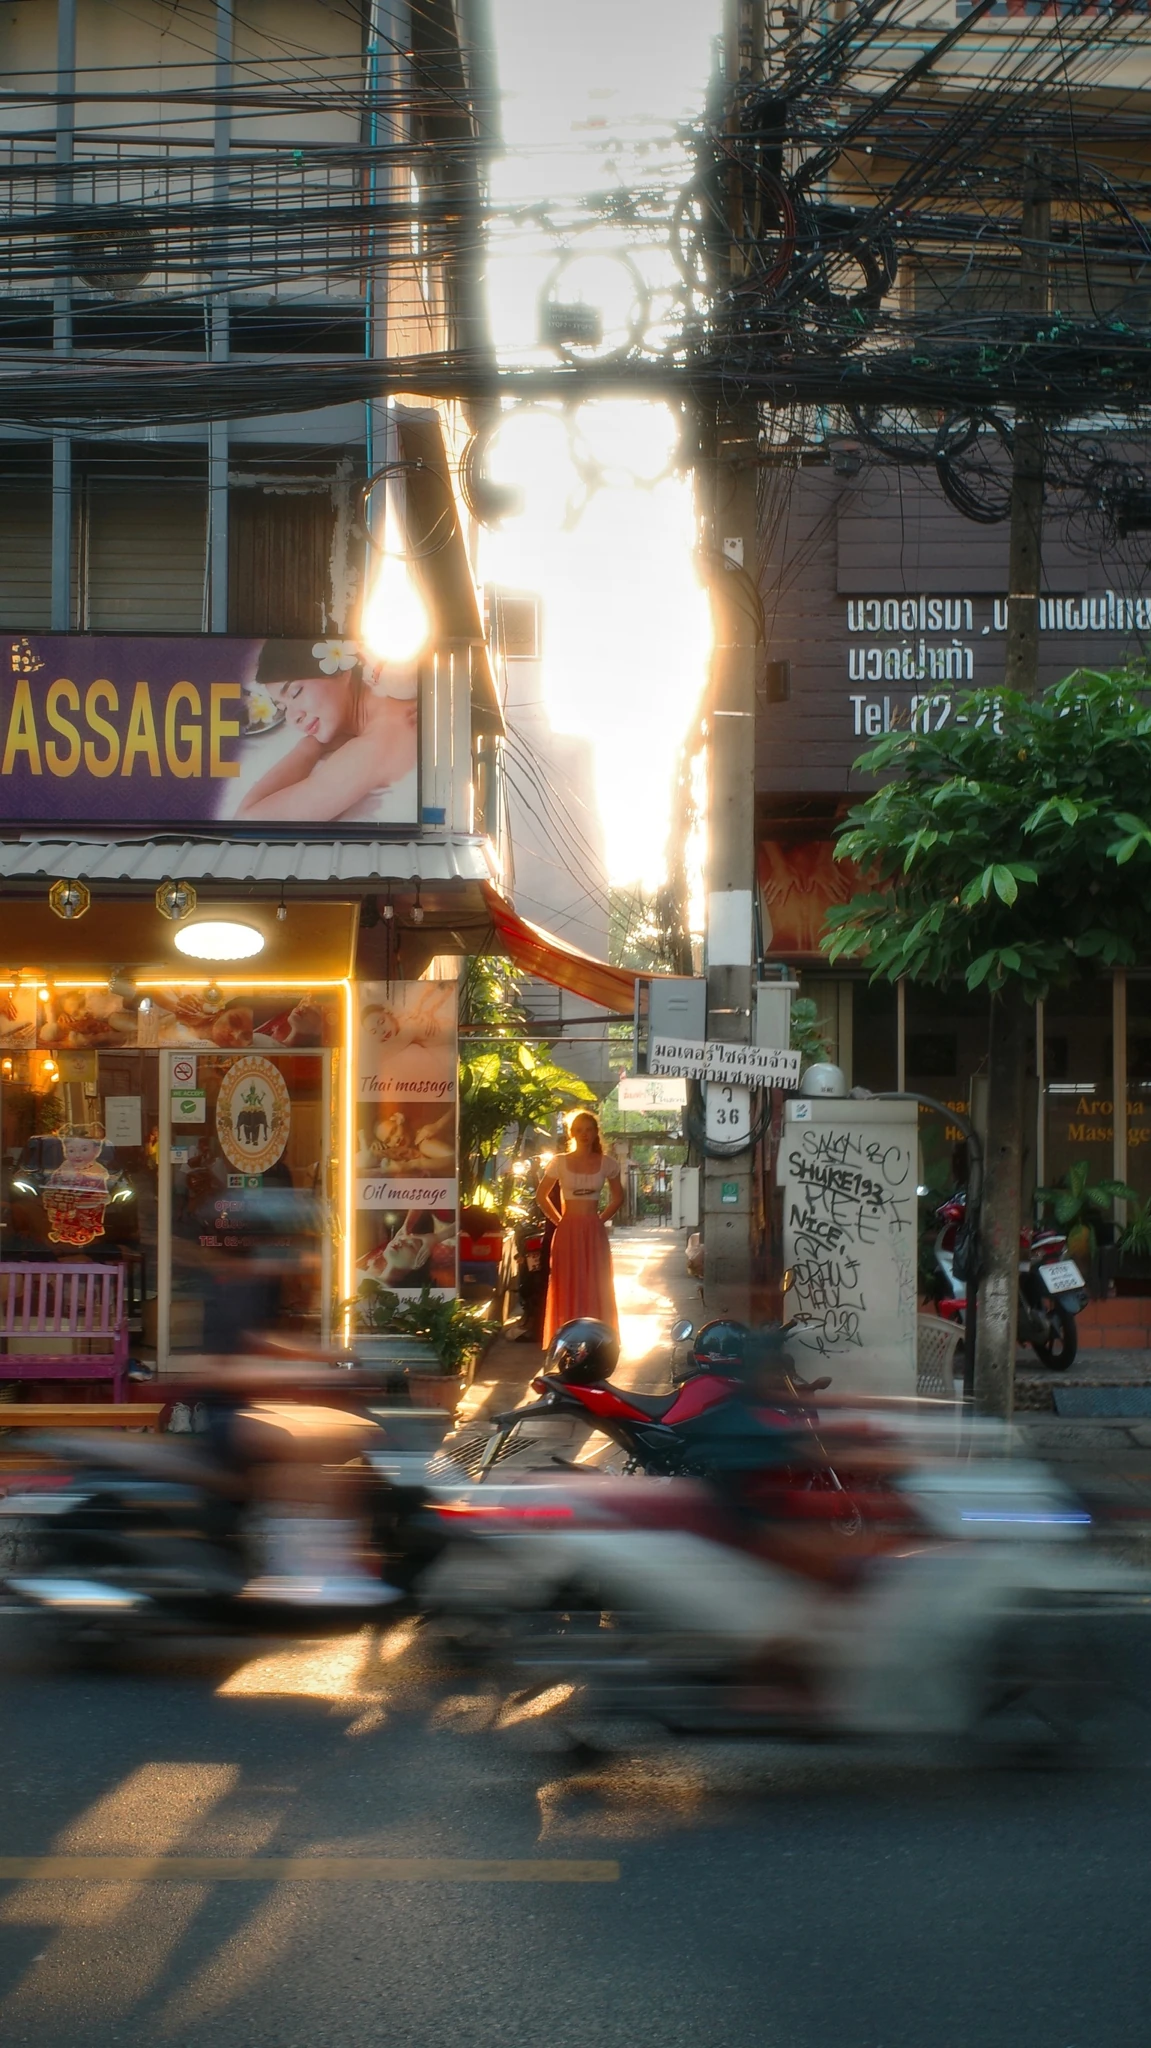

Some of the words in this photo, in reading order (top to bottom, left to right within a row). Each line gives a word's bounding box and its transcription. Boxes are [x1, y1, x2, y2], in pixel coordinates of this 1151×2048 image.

[361, 1074, 394, 1093] Thai
[395, 1079, 455, 1098] massage
[716, 1108, 740, 1125] 36
[1067, 1123, 1151, 1147] Massge
[363, 1182, 387, 1201] Oil
[387, 1188, 447, 1206] massage
